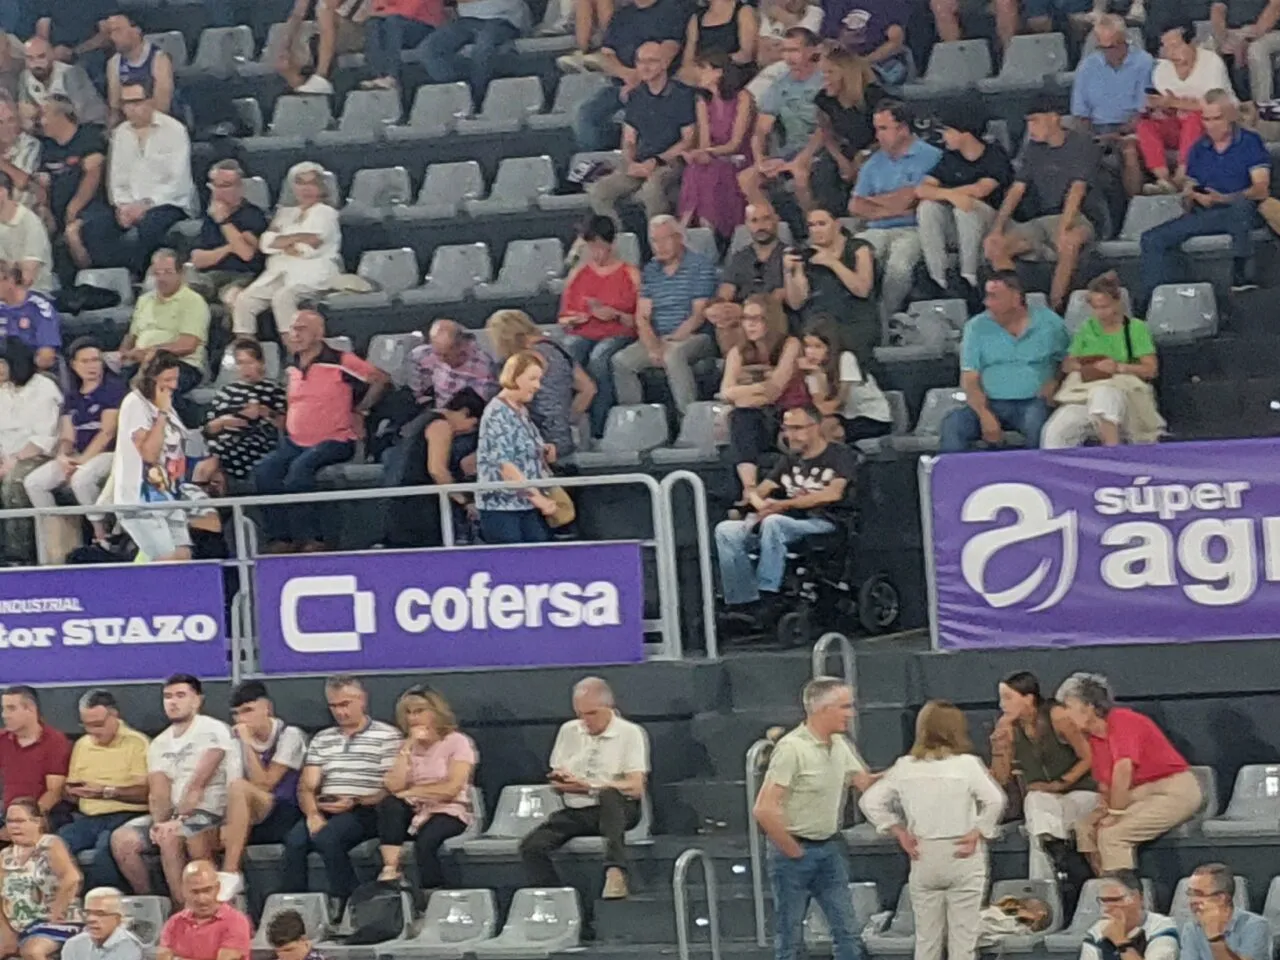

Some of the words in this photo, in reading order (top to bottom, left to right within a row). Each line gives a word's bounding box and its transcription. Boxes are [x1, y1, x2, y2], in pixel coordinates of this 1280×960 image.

[1093, 476, 1251, 520] súper
[395, 571, 621, 632] cofersa
[62, 614, 218, 646] SUAZO
